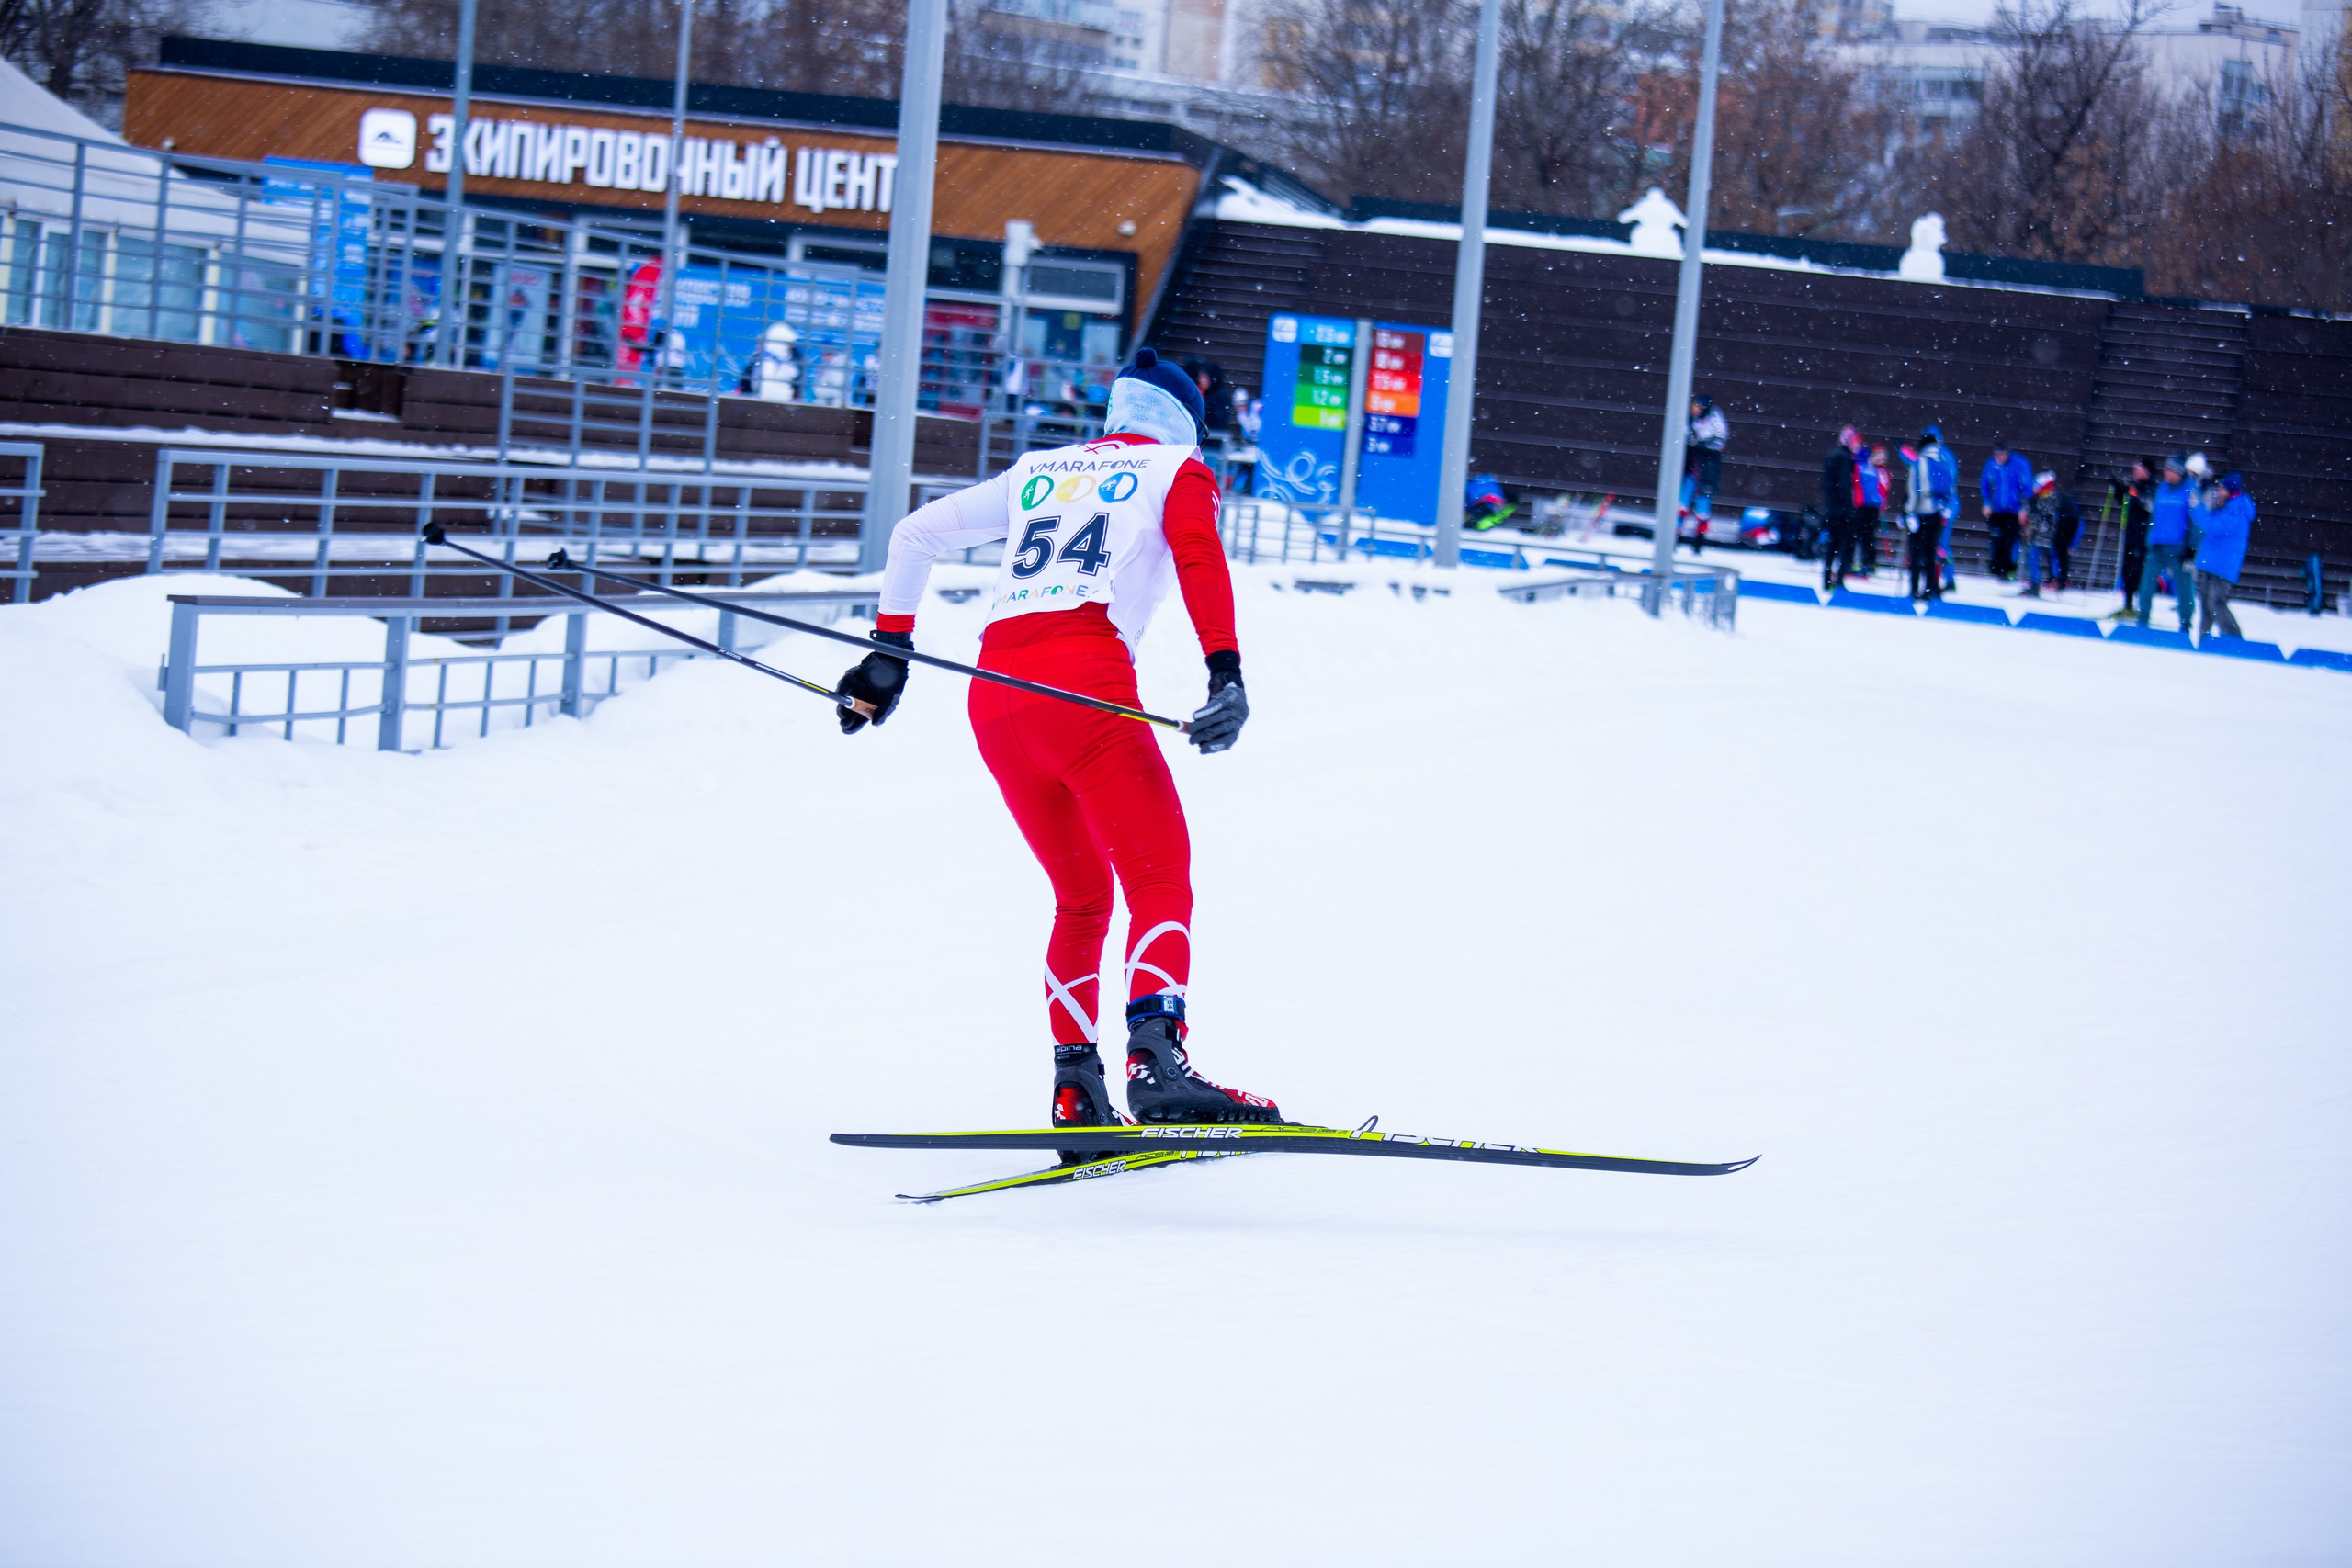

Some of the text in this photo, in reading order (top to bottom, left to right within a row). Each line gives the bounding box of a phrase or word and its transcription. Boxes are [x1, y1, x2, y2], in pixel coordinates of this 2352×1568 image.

[793, 146, 899, 214] ЦЕНТ
[1030, 459, 1151, 474] VMARAFONE
[1012, 512, 1111, 580] 54
[1140, 1126, 1244, 1139] FISCHER
[1072, 1159, 1127, 1180] FISCHER
